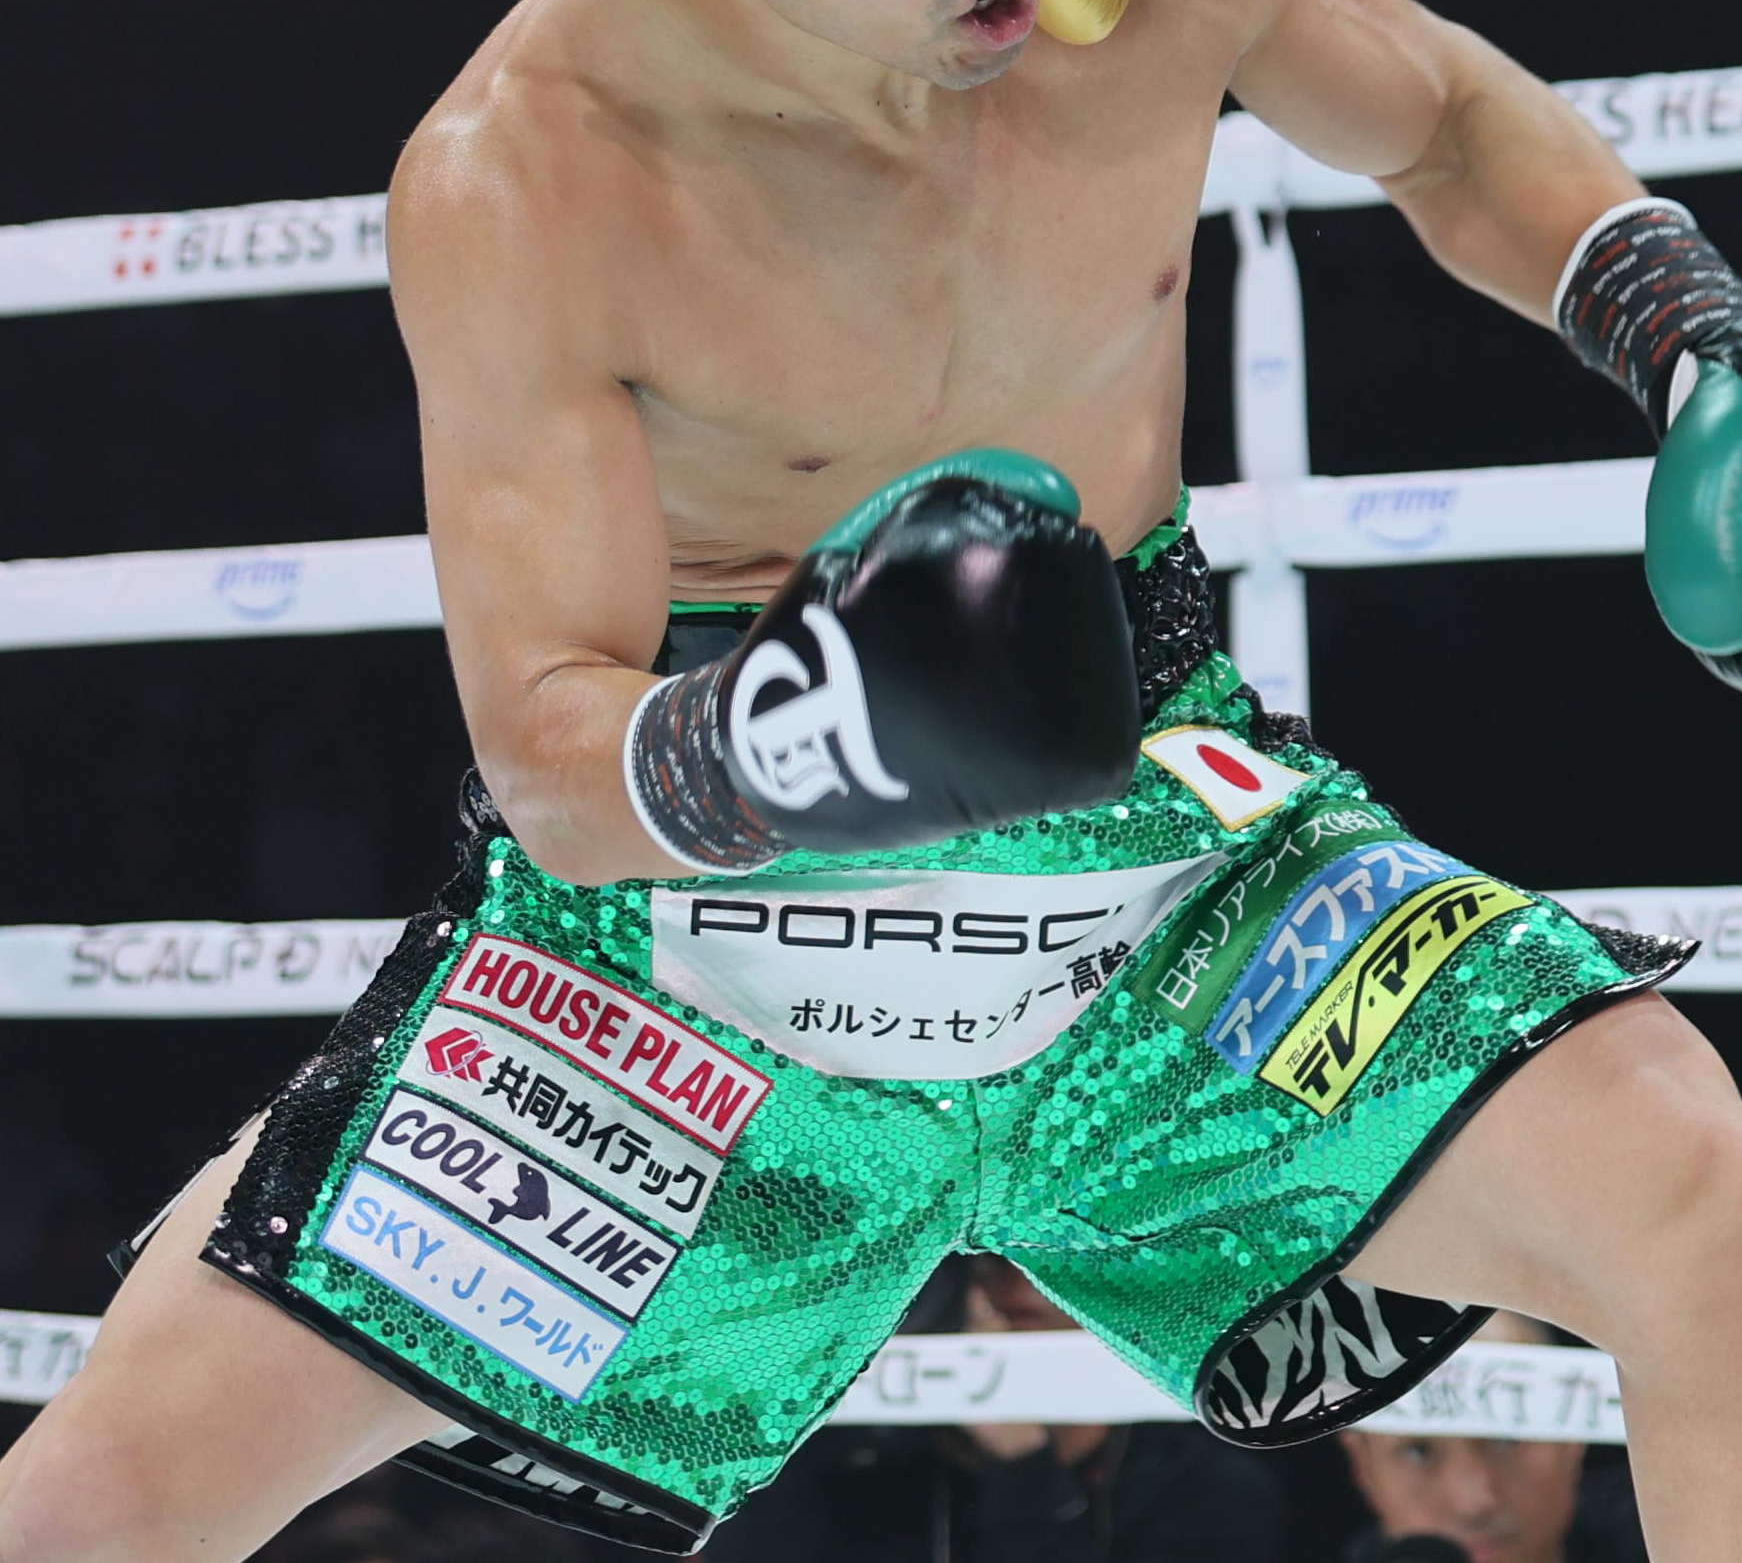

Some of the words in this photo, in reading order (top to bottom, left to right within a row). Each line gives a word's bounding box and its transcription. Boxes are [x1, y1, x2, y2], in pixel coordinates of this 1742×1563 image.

[690, 898, 1122, 956] PORSC
[462, 948, 622, 1061] HOUSE
[618, 1027, 750, 1133] PLAN
[1285, 1041, 1311, 1071] TELE
[1309, 980, 1354, 1038] MARKER
[381, 1109, 504, 1194] COOL
[546, 1207, 666, 1289] LINE
[481, 1055, 709, 1214] 共同カイテック
